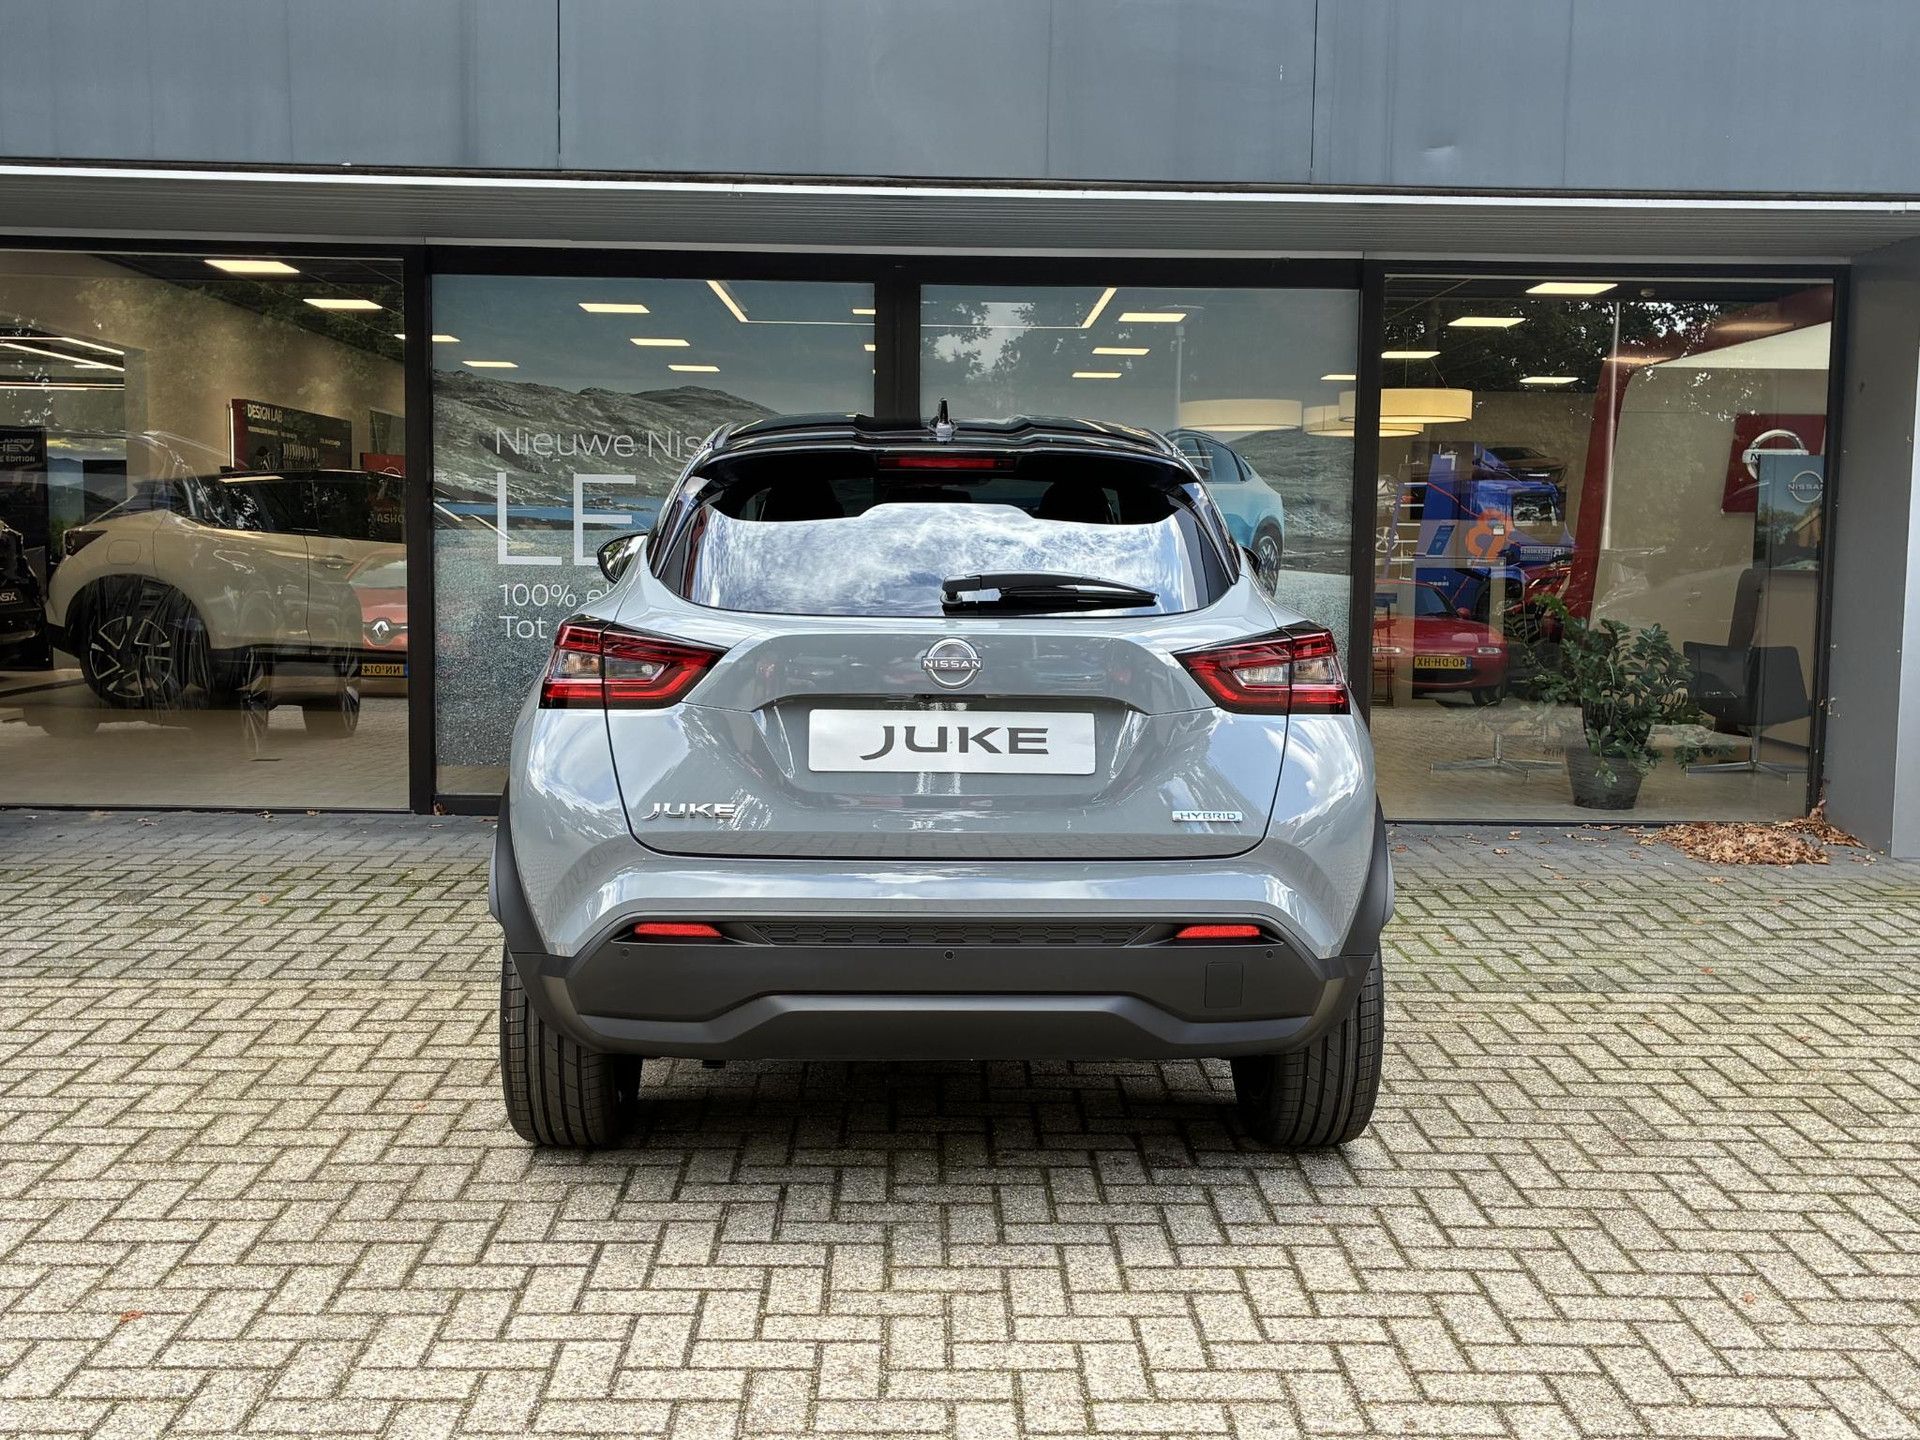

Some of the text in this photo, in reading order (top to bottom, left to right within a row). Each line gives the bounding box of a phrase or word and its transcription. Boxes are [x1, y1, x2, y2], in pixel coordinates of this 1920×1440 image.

[247, 403, 283, 423] DESIGN LAB
[496, 426, 702, 459] Nieuwe Nis
[496, 471, 637, 566] LE
[498, 583, 577, 608] 100%
[499, 615, 548, 639] Tot
[922, 659, 982, 668] NISSAN
[859, 725, 1050, 761] JUKE
[641, 802, 737, 821] JUKE
[1179, 811, 1237, 821] HYBRID
